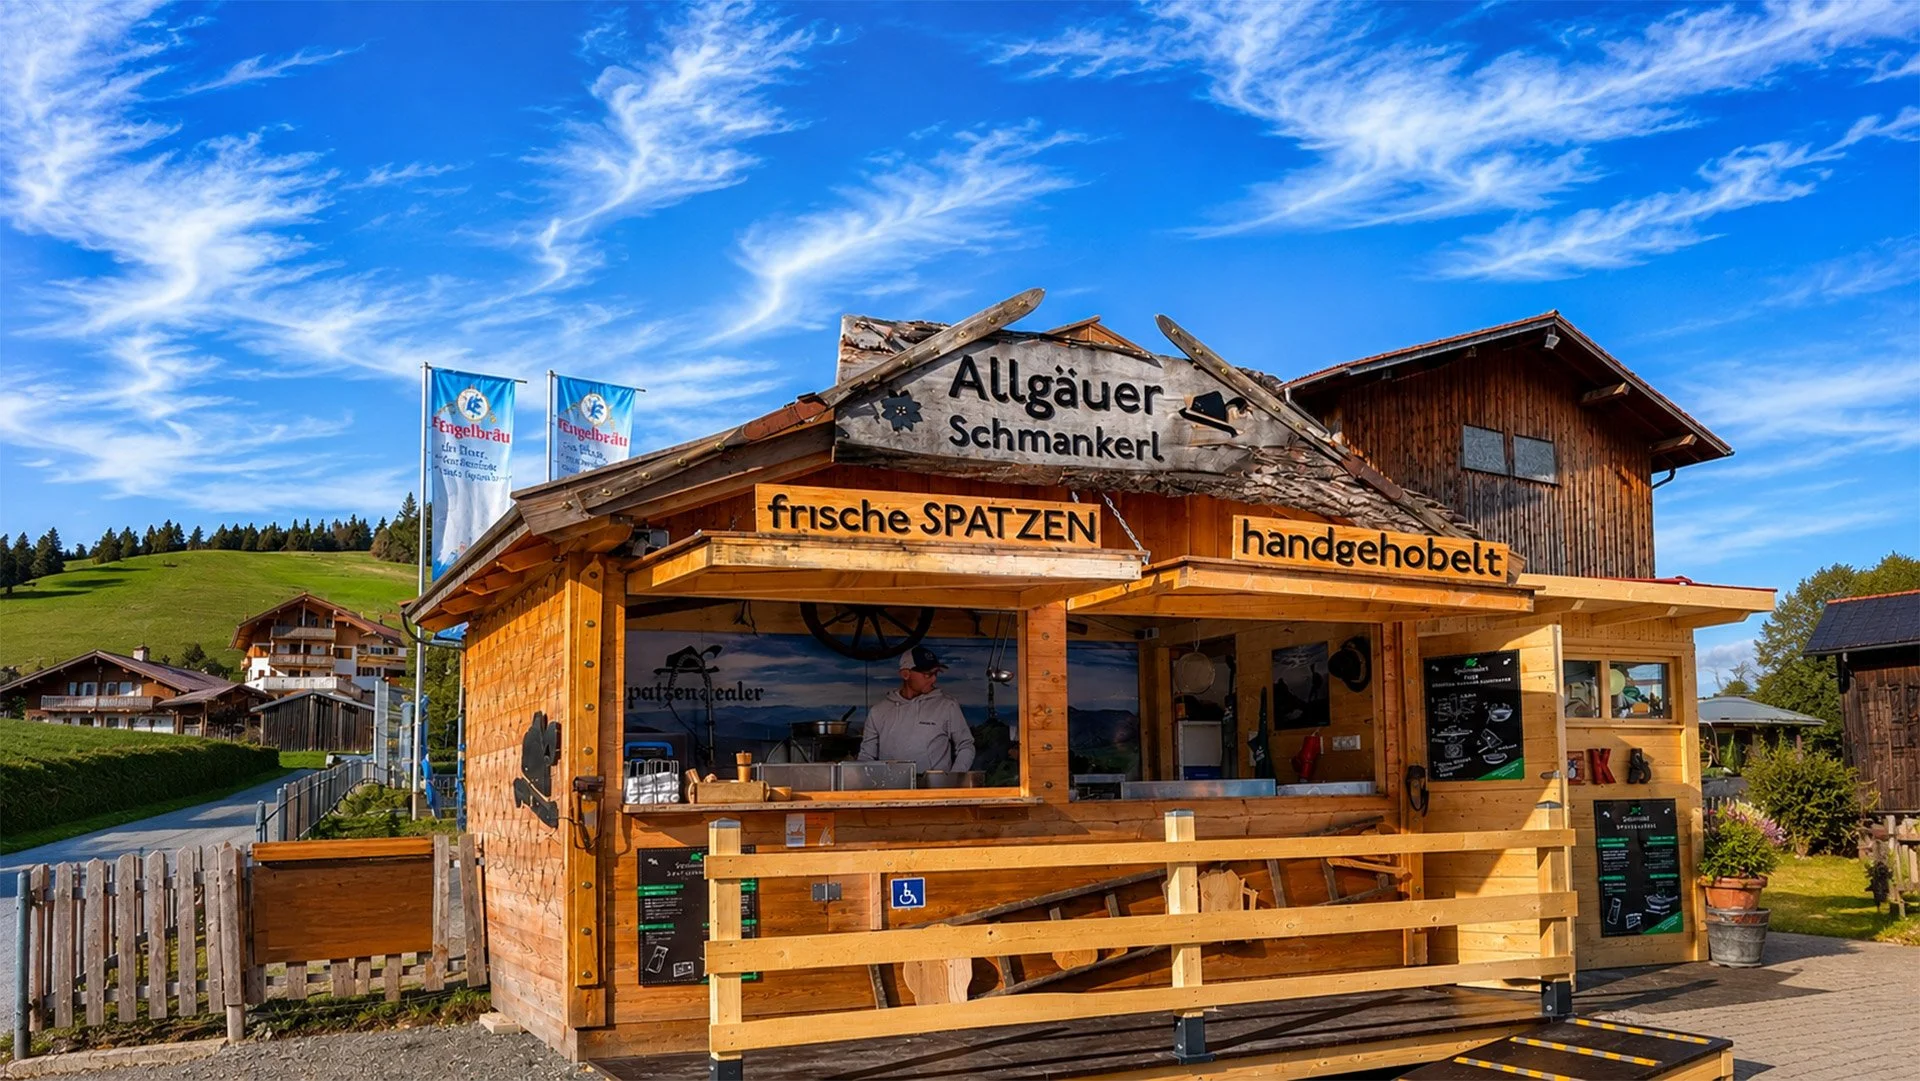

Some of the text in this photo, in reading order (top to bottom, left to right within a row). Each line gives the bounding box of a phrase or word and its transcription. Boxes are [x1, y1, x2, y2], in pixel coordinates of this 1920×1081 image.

[948, 354, 1164, 420] Allgäuer
[948, 414, 1165, 463] Schmankerl
[767, 493, 1097, 544] frische SPATZEN
[1242, 518, 1503, 577] handgehobelt
